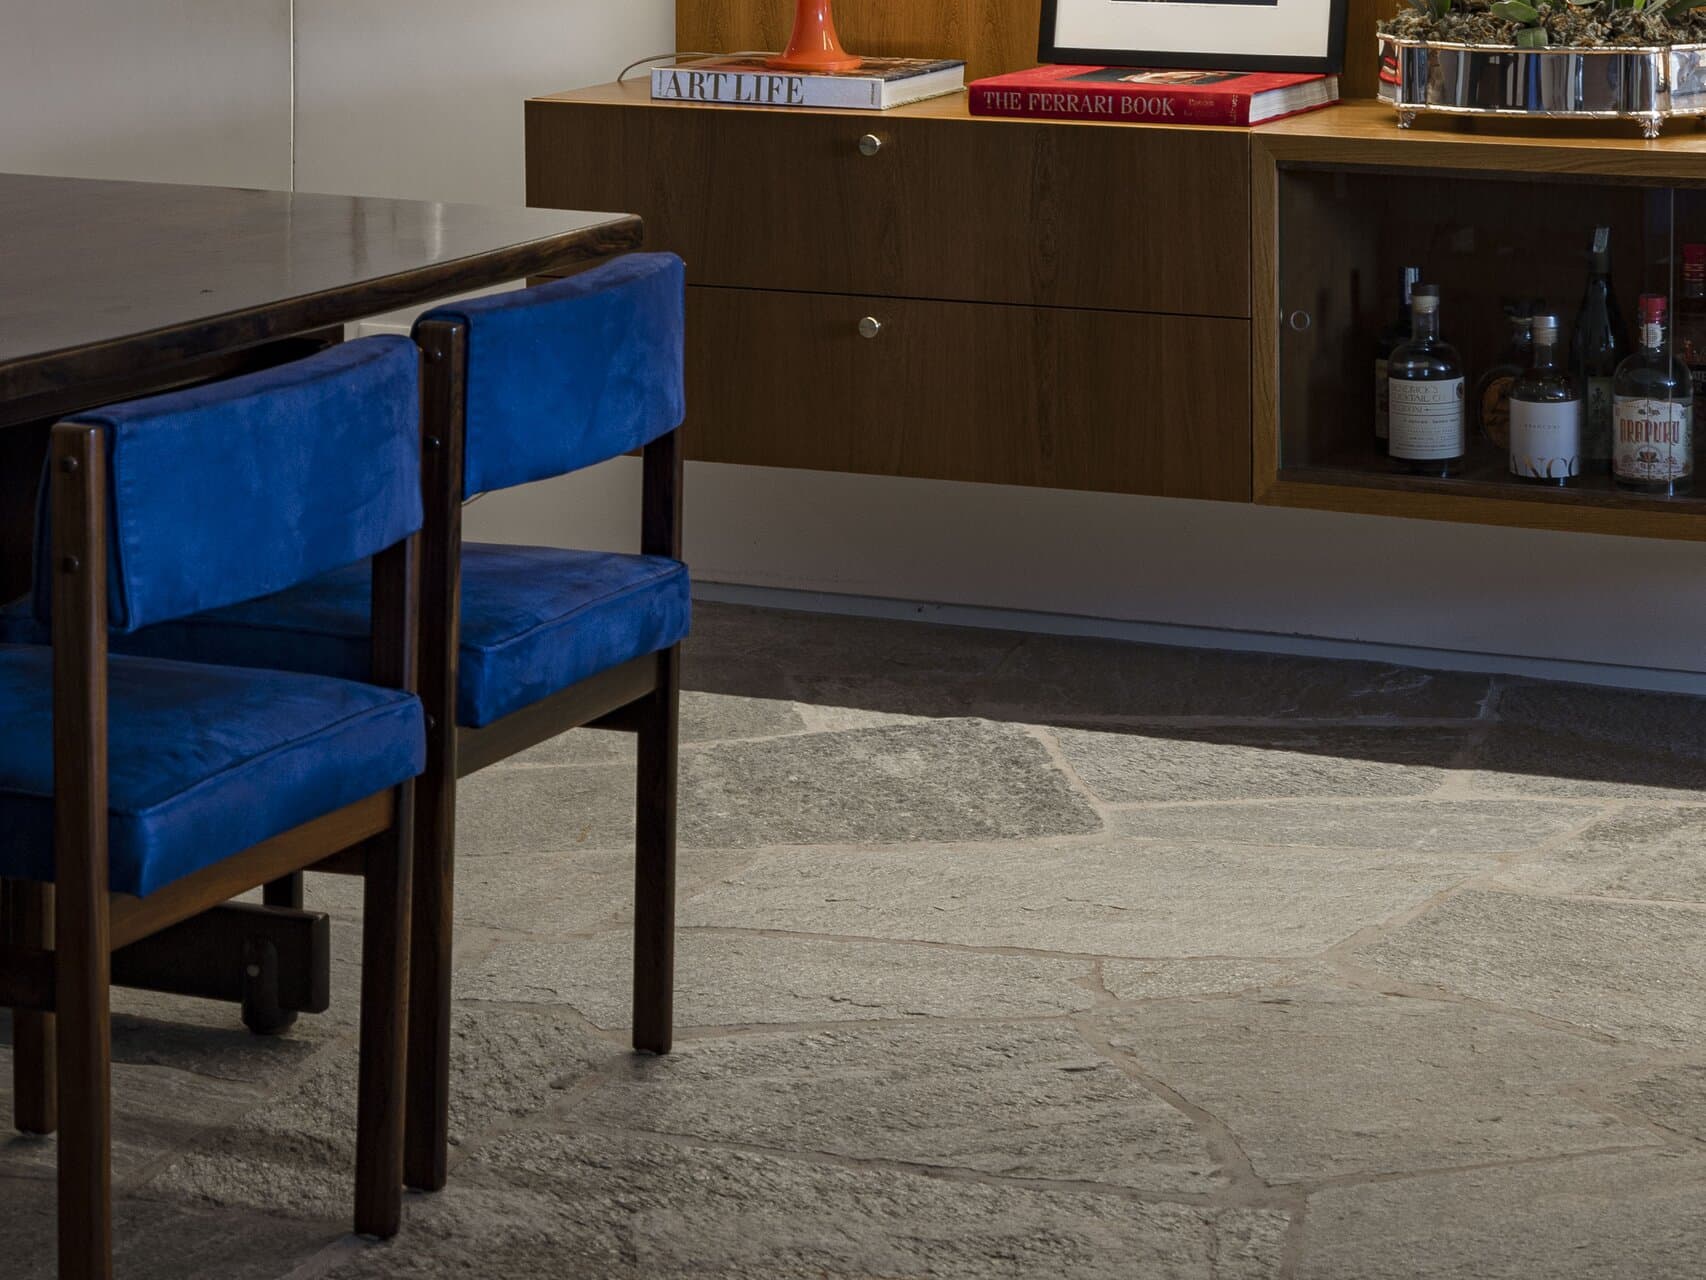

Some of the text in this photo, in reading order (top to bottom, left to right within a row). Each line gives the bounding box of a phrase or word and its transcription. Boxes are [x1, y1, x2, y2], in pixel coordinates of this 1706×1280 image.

[663, 70, 728, 100] ART
[734, 74, 805, 104] LIFE
[983, 91, 1022, 111] THE
[1028, 92, 1114, 115] FERRARI
[1121, 96, 1175, 117] BOOK
[1619, 418, 1680, 444] ARAPURU
